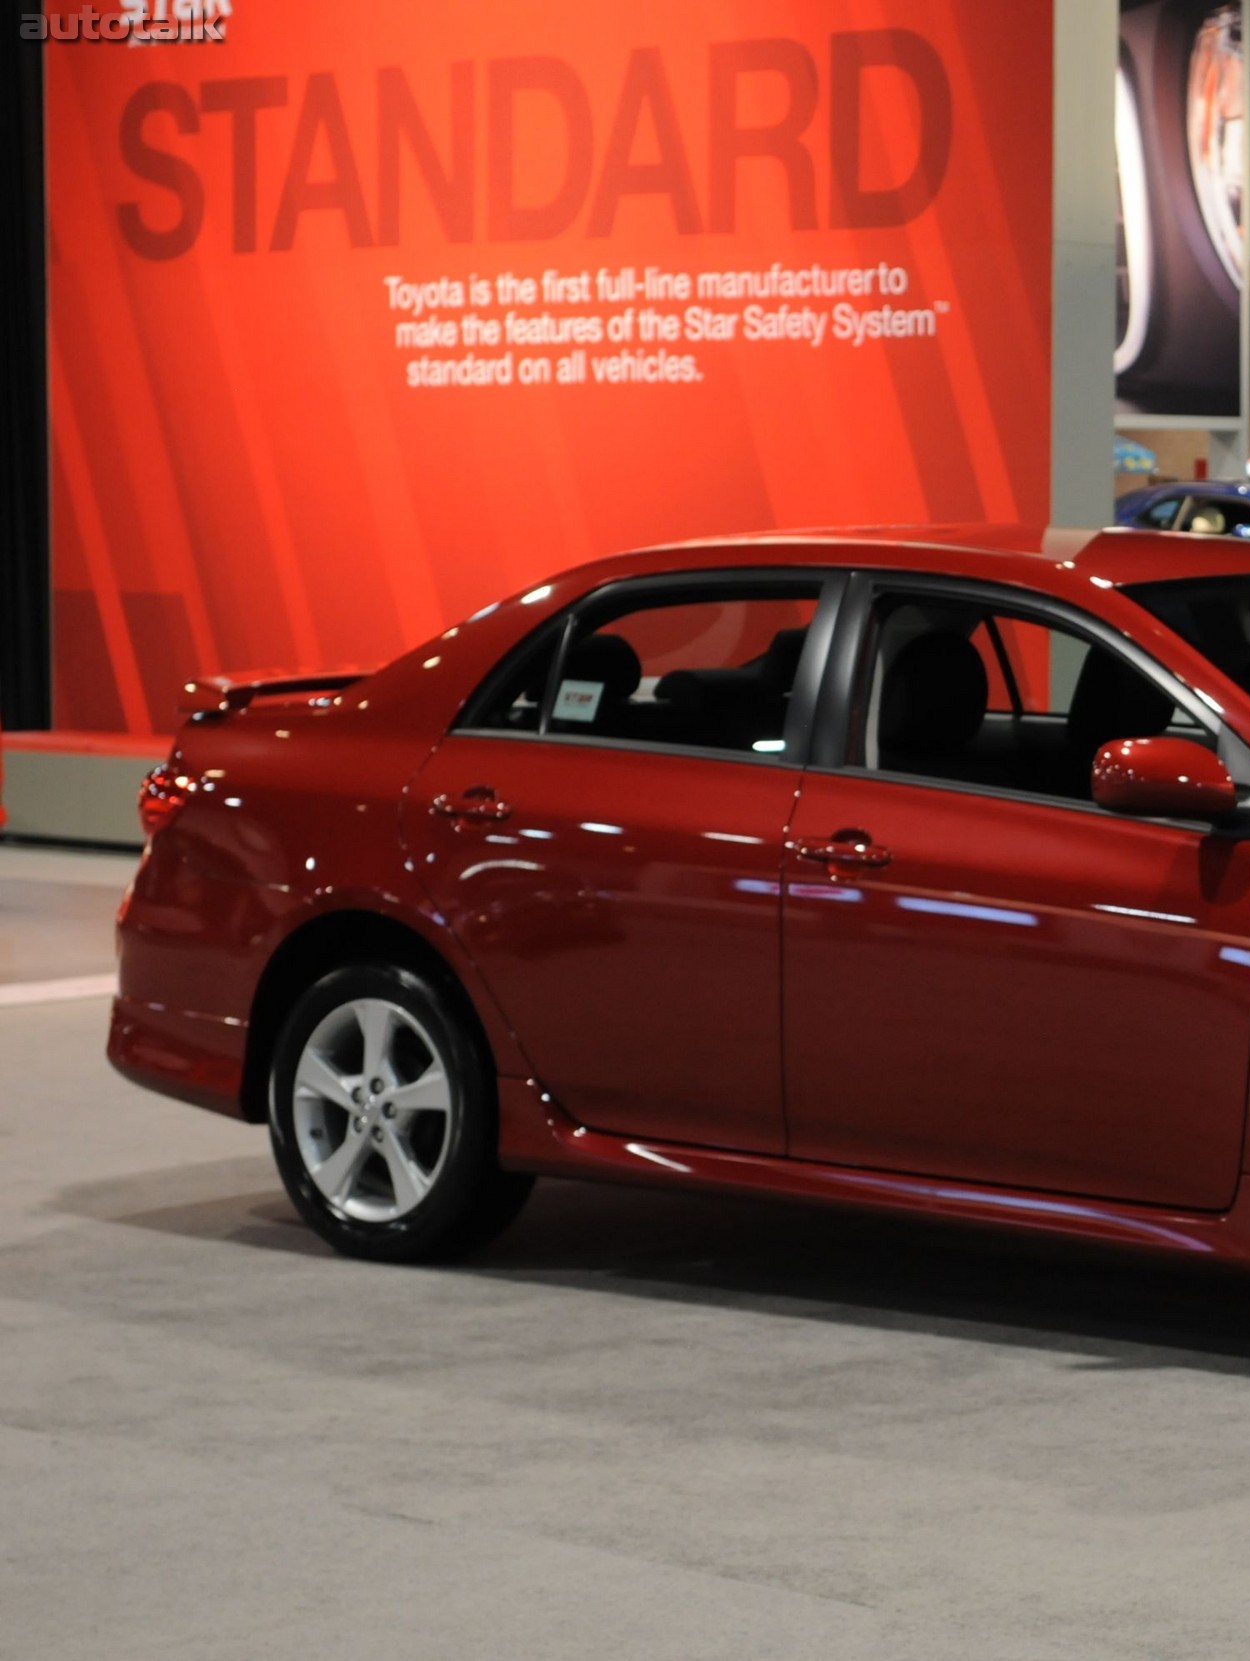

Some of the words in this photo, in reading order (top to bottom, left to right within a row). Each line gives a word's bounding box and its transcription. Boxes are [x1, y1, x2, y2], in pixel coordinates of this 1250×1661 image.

[115, 27, 953, 263] STANDARD
[384, 275, 464, 317] Toyota
[468, 273, 492, 306] is
[496, 272, 538, 306] the
[542, 269, 591, 304] first
[596, 266, 691, 302] full-line
[697, 262, 875, 299] manufacturer
[876, 261, 908, 295] to
[395, 314, 458, 348] make
[461, 312, 501, 346] the
[504, 310, 604, 345] features
[606, 307, 635, 343] of
[637, 307, 682, 342] the
[684, 305, 739, 342] Star
[742, 303, 828, 348] Safety
[406, 351, 513, 388] standard
[517, 356, 552, 385] on
[555, 349, 586, 385] all
[591, 347, 704, 384] vehicles.
